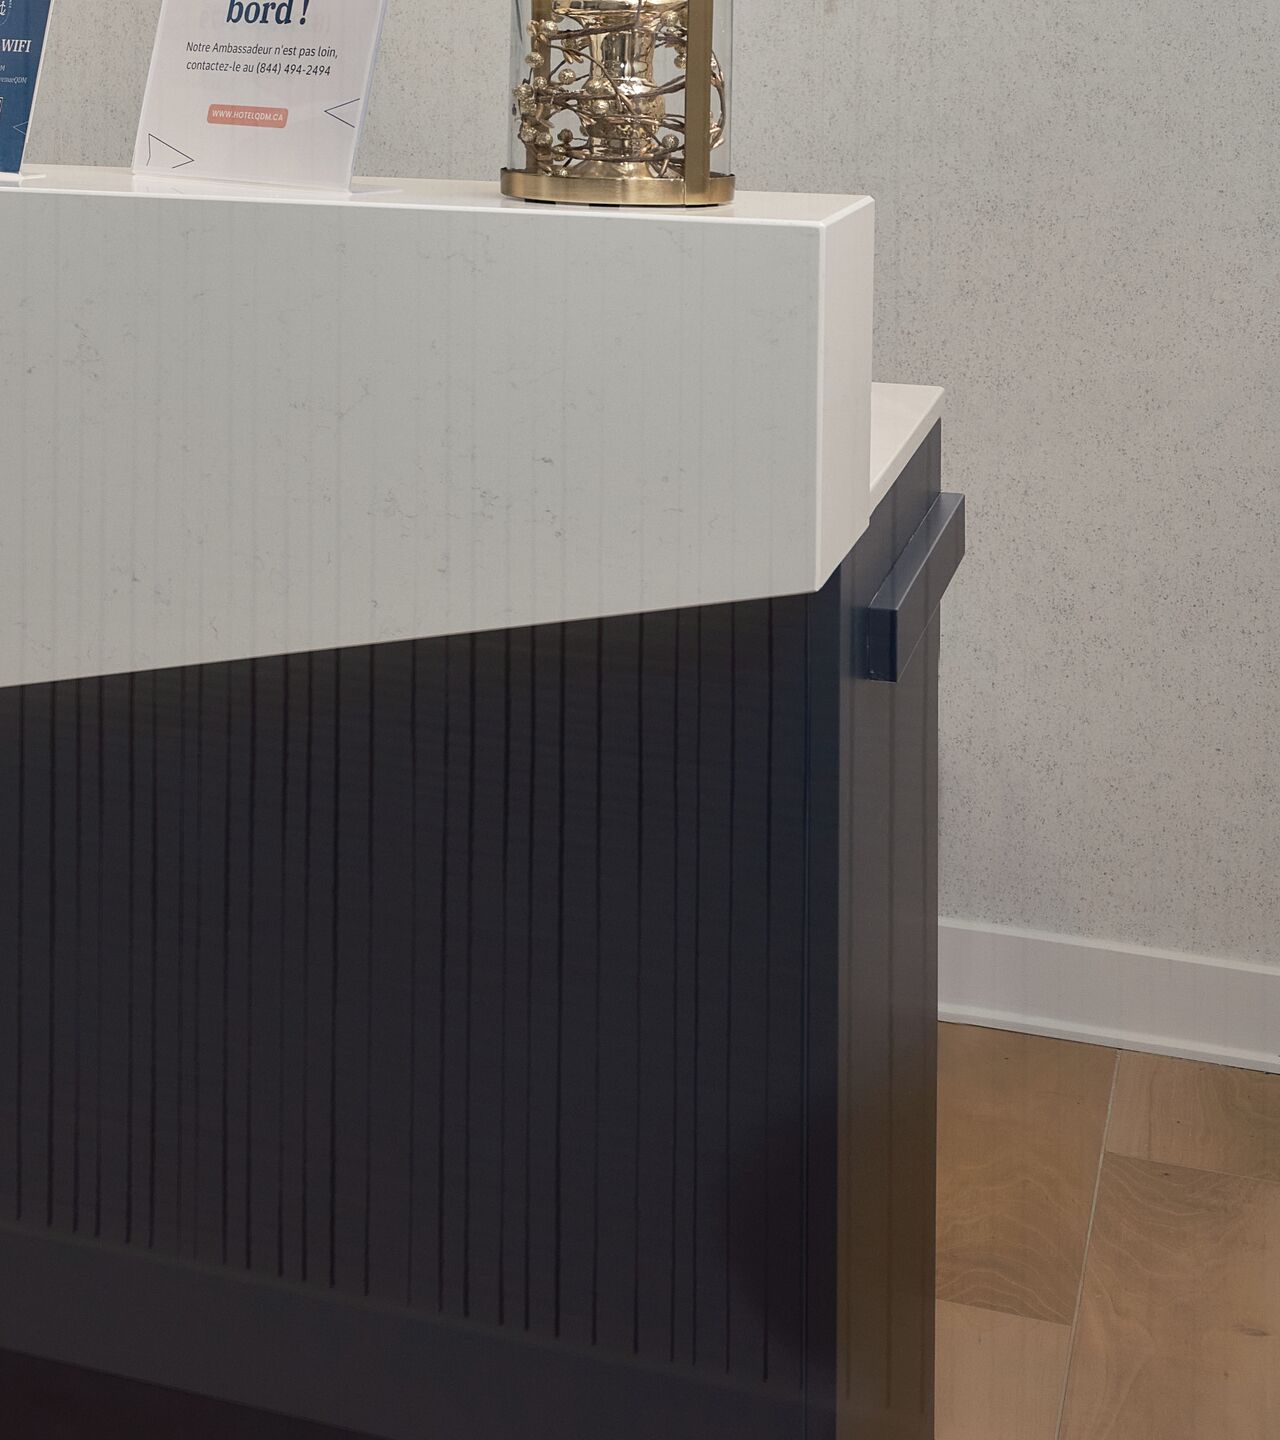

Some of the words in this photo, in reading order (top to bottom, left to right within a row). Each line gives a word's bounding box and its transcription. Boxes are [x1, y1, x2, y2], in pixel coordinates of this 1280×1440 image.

[2, 38, 32, 53] WIFI
[186, 41, 211, 53] Notre
[212, 42, 273, 56] Ambassadeur
[274, 44, 297, 56] n'est
[298, 47, 316, 59] pas
[317, 45, 338, 59] loin,
[186, 60, 241, 73] contactez-le
[243, 63, 254, 73] au
[256, 62, 282, 75] (844)
[284, 64, 332, 77] 494-2494
[212, 109, 284, 121] WWW.HOTELQDM.CA
